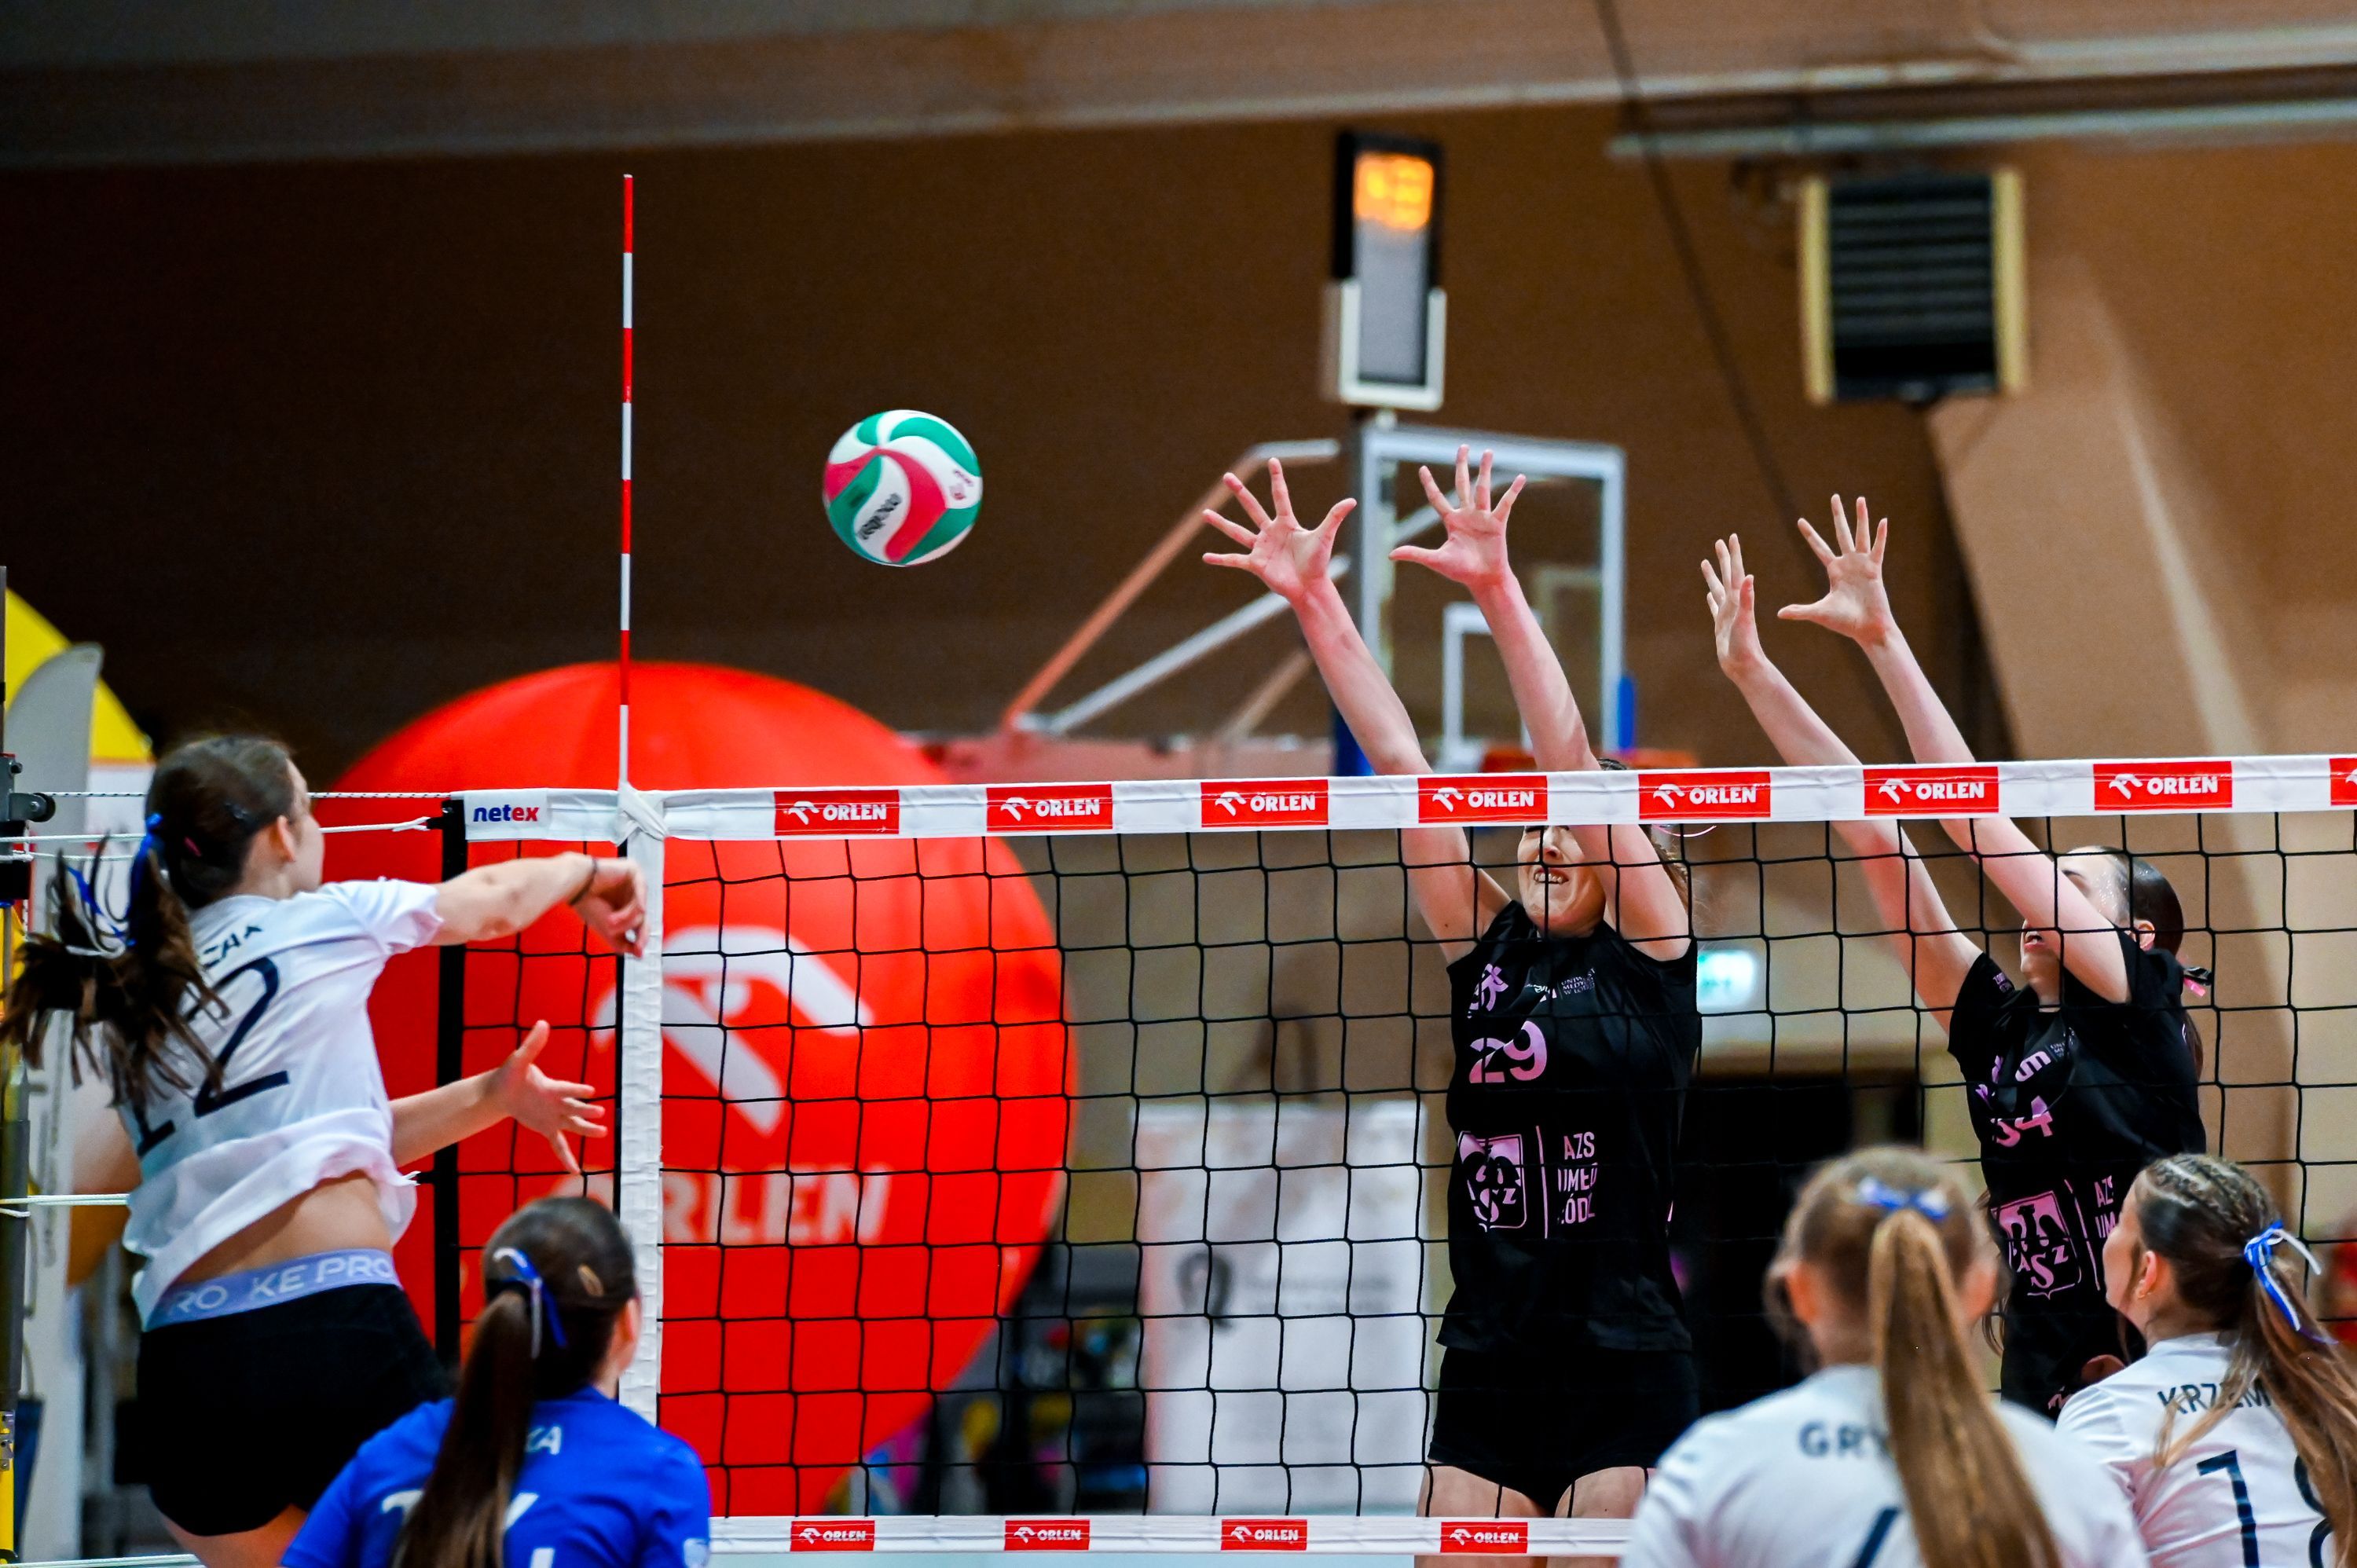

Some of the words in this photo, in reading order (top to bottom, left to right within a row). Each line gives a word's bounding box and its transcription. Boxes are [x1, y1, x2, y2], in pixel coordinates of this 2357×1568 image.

[1915, 782, 1985, 800] ORLEN
[2146, 776, 2217, 795] ORLEN
[1250, 795, 1315, 811] ORLEN
[1468, 791, 1534, 808] ORLEN
[1689, 787, 1757, 804] ORLEN
[473, 804, 539, 822] netex
[823, 804, 886, 821] ORLEN
[1035, 800, 1100, 816] ORLEN
[1468, 1020, 1548, 1084] 29
[1563, 1132, 1595, 1160] AZS
[554, 1164, 893, 1245] RLEN
[316, 1255, 394, 1284] PRO
[823, 1530, 866, 1541] ORLEN
[1036, 1530, 1081, 1541] ORLEN
[1253, 1530, 1299, 1542] ORLEN
[1473, 1531, 1519, 1543] ORLEN
